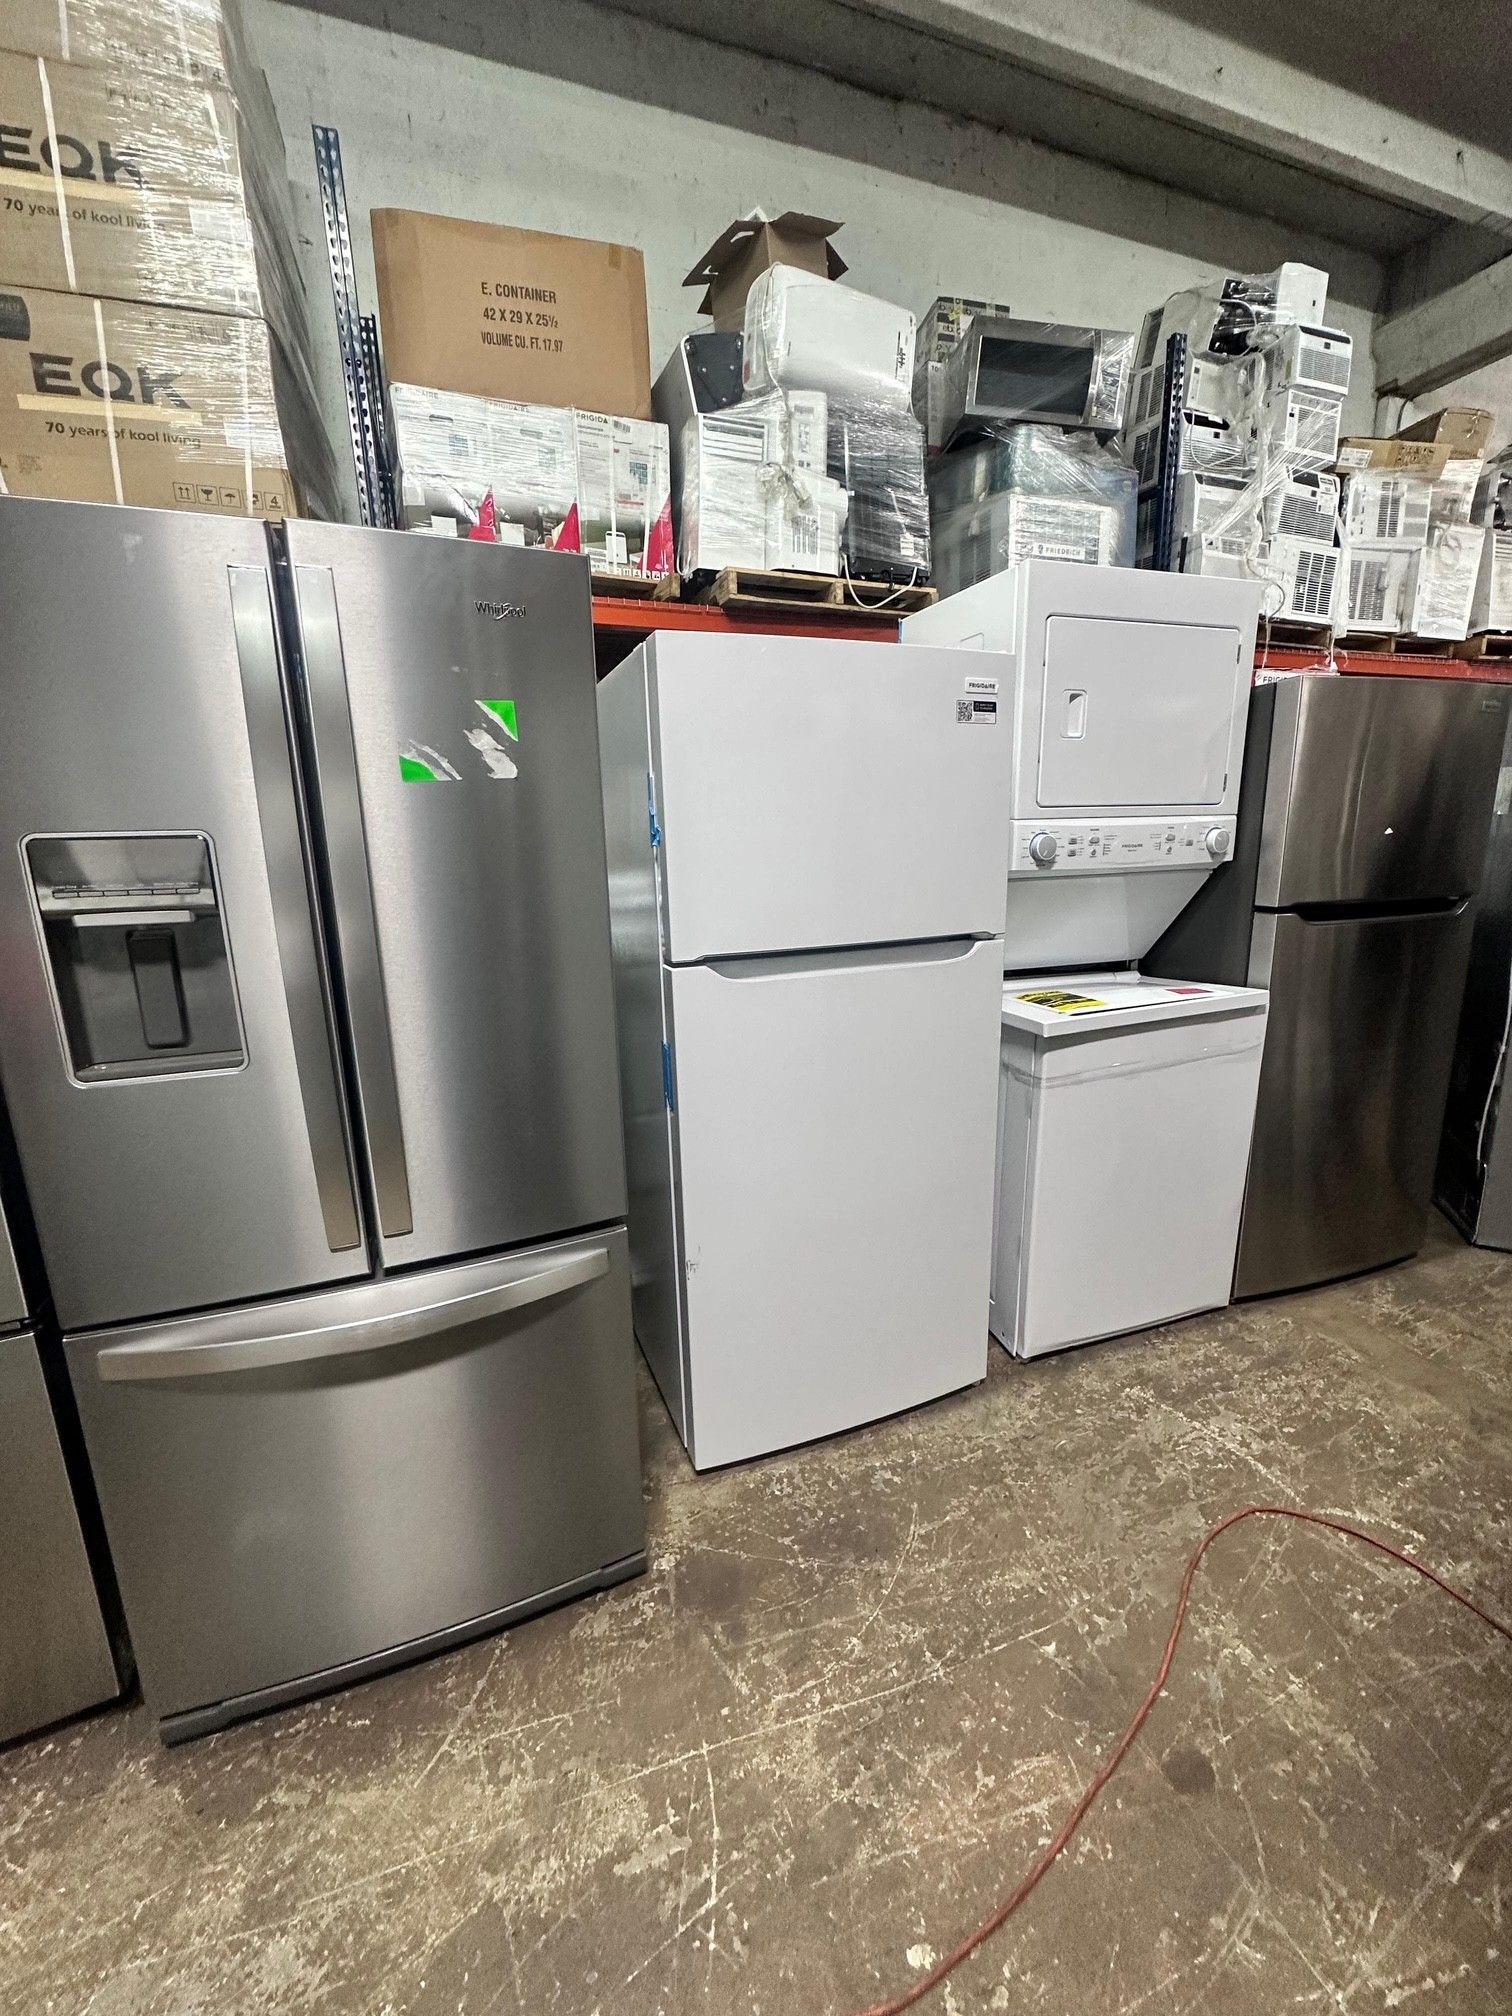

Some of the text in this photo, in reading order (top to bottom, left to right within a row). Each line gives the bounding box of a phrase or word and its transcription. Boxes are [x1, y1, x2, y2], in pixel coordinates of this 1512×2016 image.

[4, 197, 23, 211] 70
[29, 203, 60, 216] year
[73, 208, 86, 220] of
[91, 210, 122, 225] kool
[481, 282, 557, 304] E. CONTAINER
[483, 307, 496, 321] 42
[499, 309, 507, 322] X
[509, 310, 523, 324] 29
[525, 312, 534, 325] X
[480, 331, 563, 353] VOLUME CU. FT. 17.97
[29, 352, 192, 409] EQK
[576, 411, 609, 424] FRIGIDA
[45, 421, 65, 434] 70
[68, 425, 107, 438] years
[129, 429, 160, 442] kool
[474, 600, 527, 621] Whirlpool
